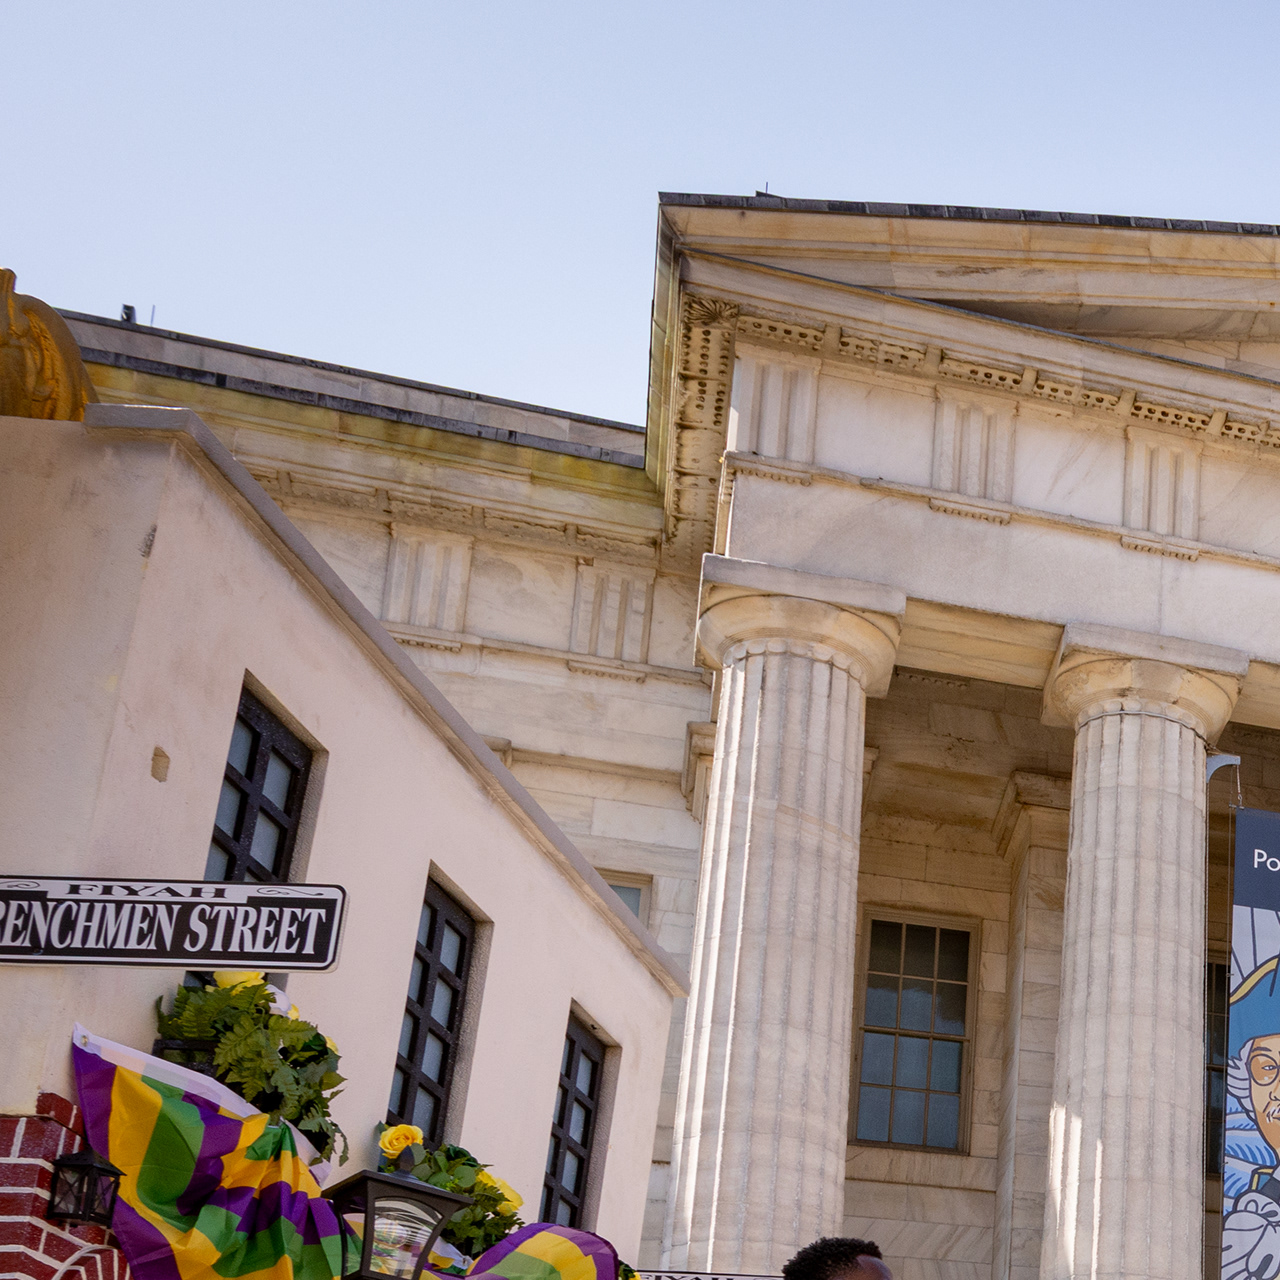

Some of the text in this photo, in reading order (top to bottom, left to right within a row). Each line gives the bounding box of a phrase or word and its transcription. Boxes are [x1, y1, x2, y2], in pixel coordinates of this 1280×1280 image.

[67, 884, 228, 899] FIYAH
[0, 900, 327, 955] ENCHMEN STREET
